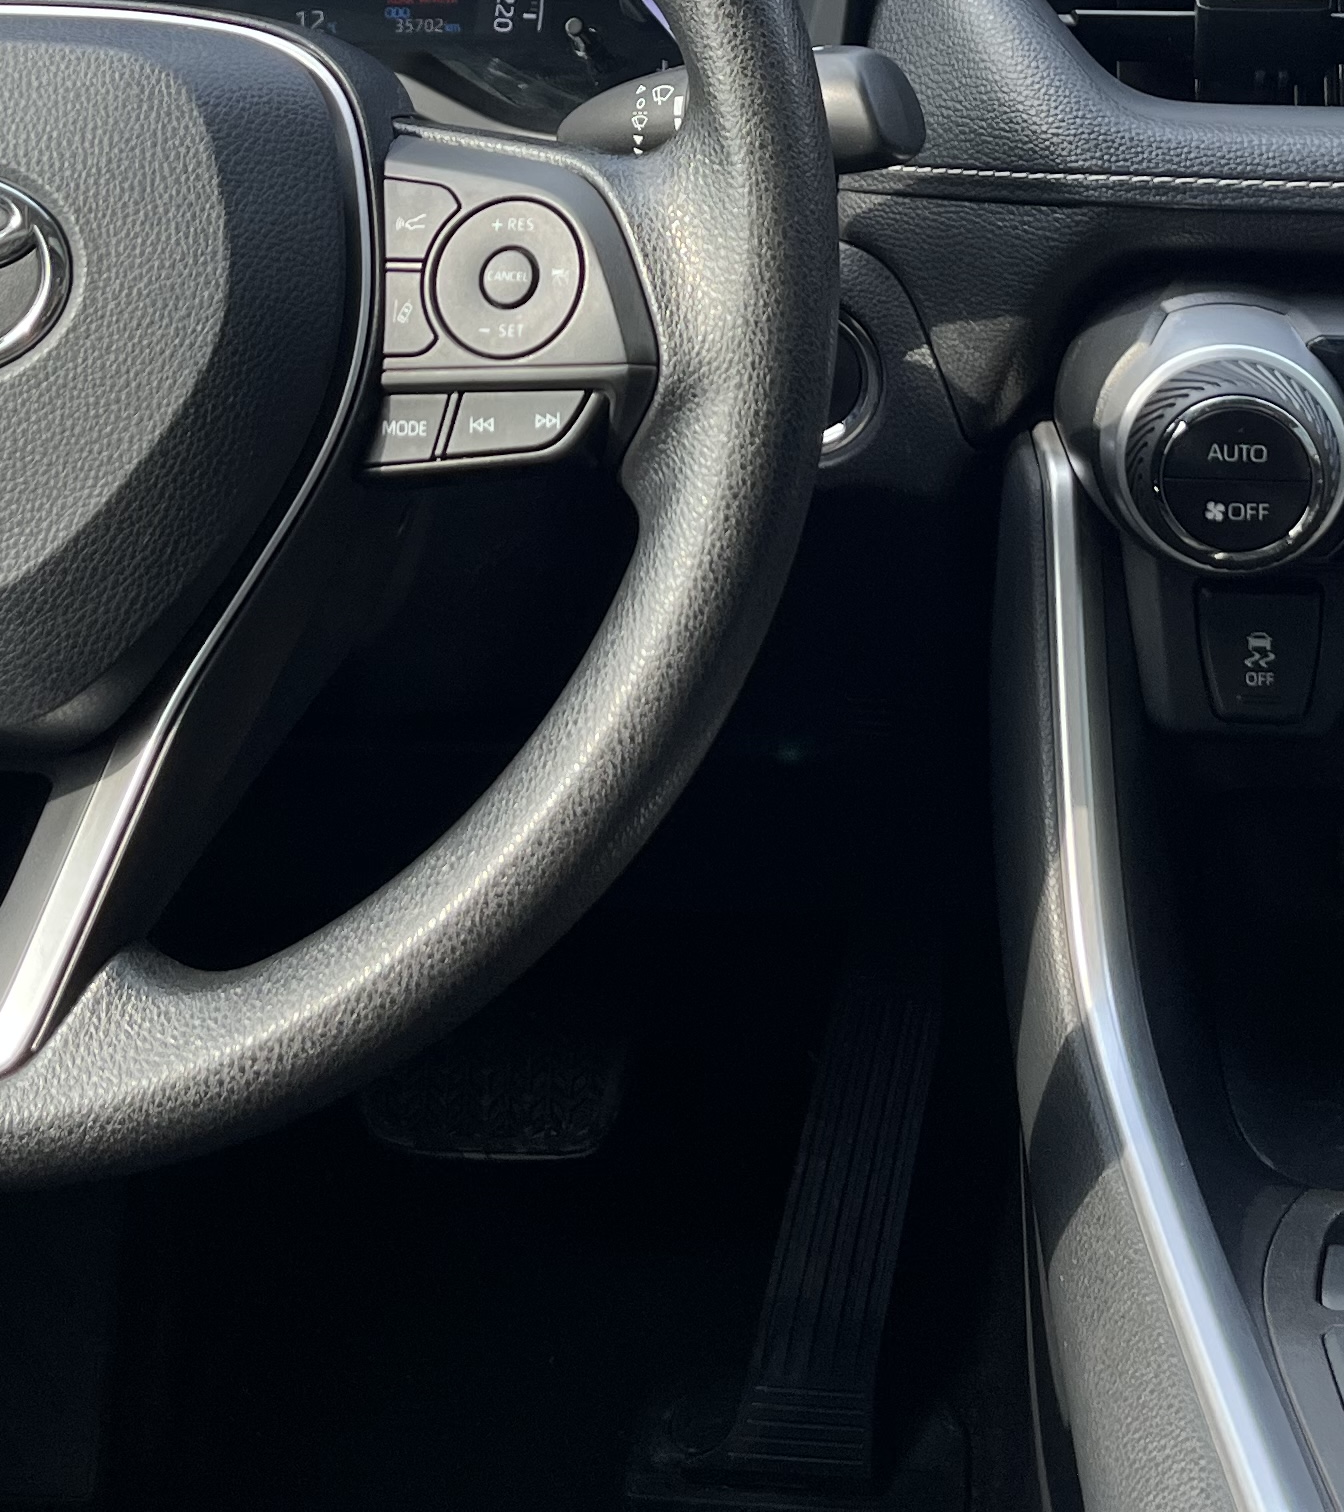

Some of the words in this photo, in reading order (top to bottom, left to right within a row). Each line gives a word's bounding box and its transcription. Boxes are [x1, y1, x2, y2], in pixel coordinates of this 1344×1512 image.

[395, 18, 444, 33] 35702
[507, 217, 534, 232] RES
[498, 324, 524, 337] SET
[382, 420, 427, 437] MODE
[1207, 443, 1268, 463] AUTO
[1227, 502, 1270, 521] OFF
[1245, 671, 1275, 686] OFF
